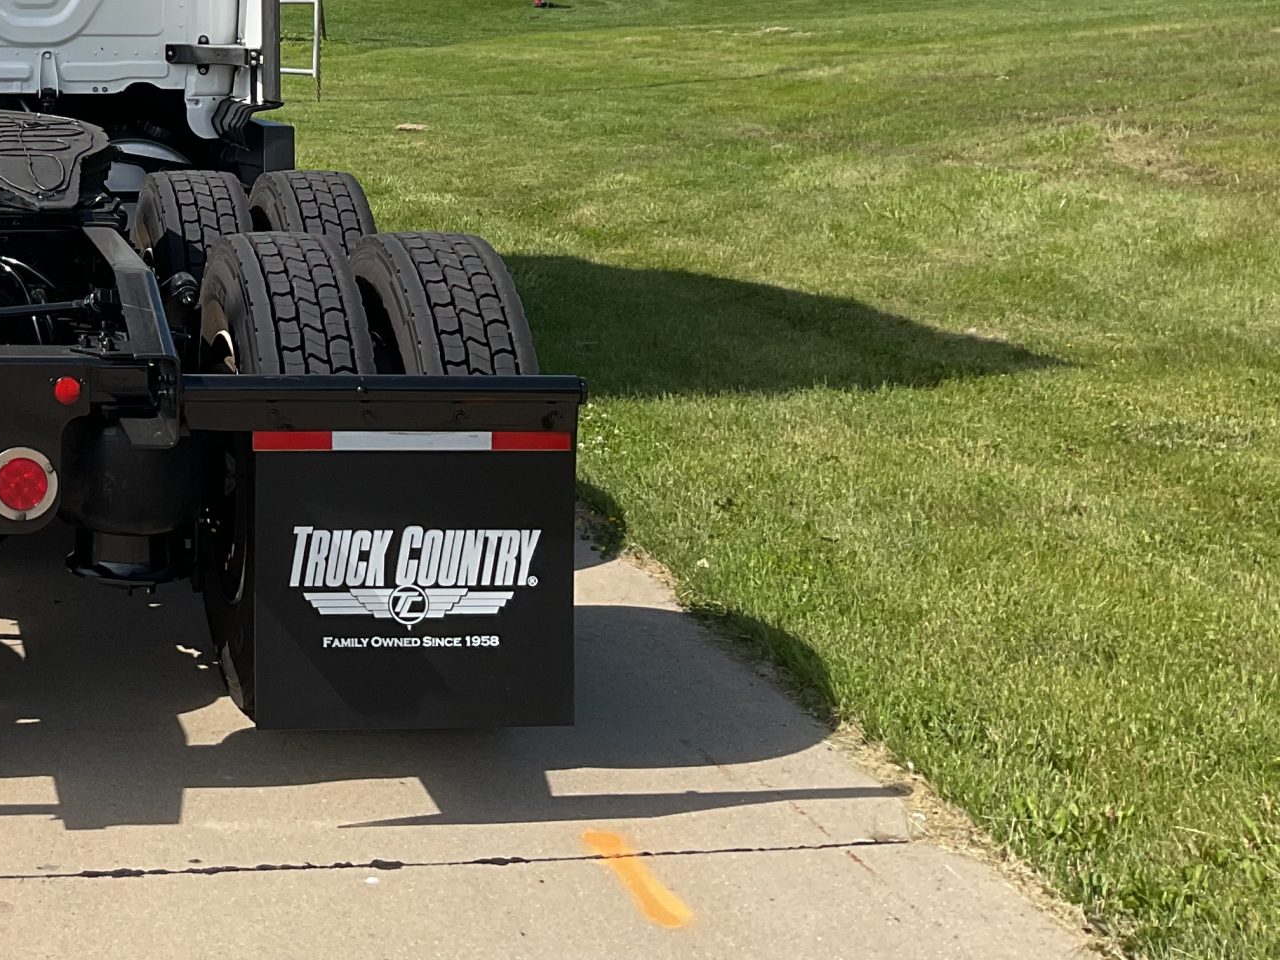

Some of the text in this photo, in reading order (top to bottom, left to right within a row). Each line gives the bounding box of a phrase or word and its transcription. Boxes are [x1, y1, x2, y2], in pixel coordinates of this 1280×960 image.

[289, 526, 393, 587] TRUCK
[322, 635, 500, 648] FAMILY OWNED SINCE 1958
